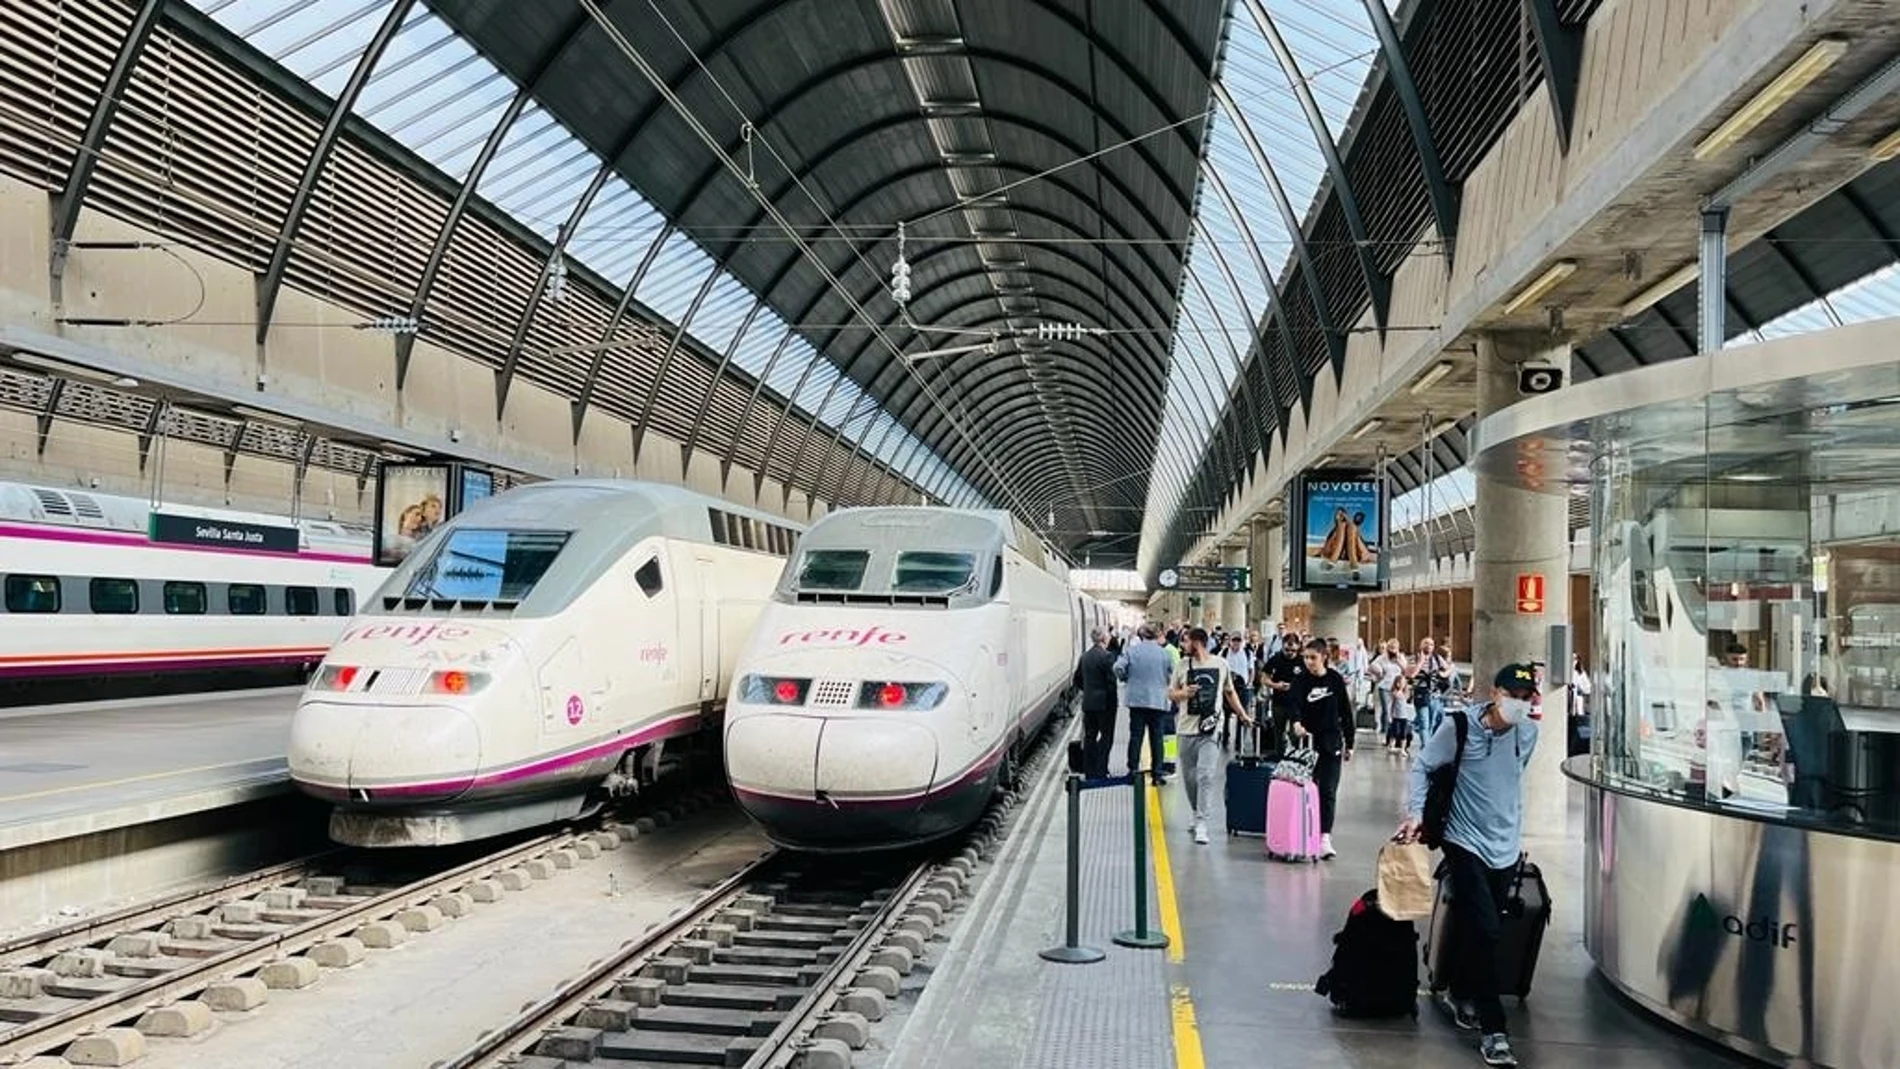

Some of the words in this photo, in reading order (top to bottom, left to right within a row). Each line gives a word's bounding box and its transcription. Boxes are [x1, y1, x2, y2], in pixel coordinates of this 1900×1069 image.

[196, 525, 221, 538] Sevilla
[222, 528, 244, 541] Santa
[245, 531, 265, 543] Justa
[342, 623, 470, 646] renfe
[780, 625, 906, 645] renfe
[1722, 915, 1797, 949] adif
